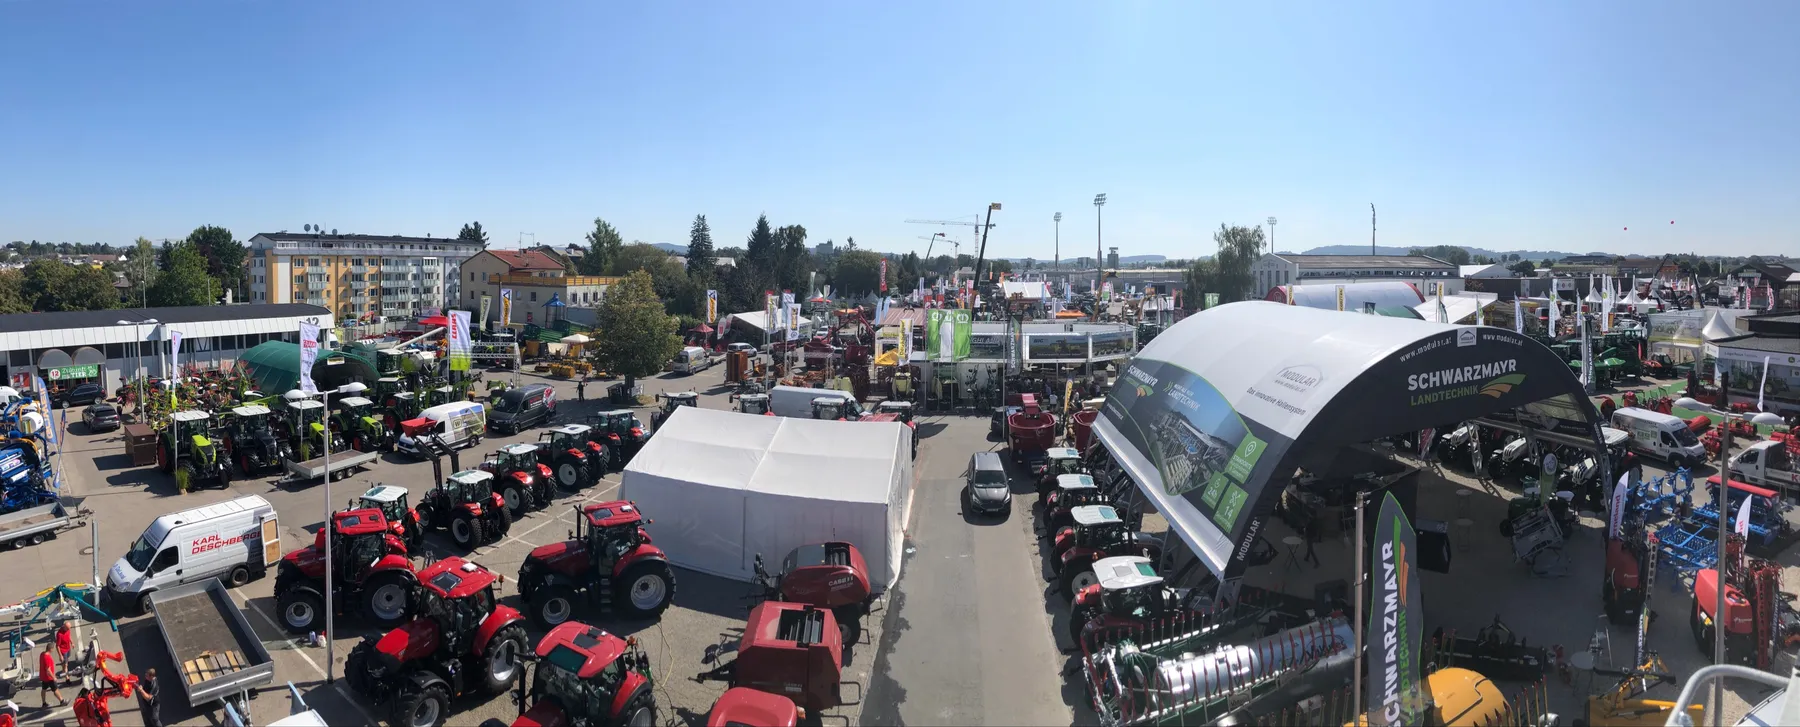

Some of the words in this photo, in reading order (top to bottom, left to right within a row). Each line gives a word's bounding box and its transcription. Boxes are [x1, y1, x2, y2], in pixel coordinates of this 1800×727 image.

[1280, 370, 1316, 387] MODULAR
[1407, 359, 1517, 391] SCHWARZMAYR
[1410, 385, 1479, 406] LANDTECHNIK
[192, 533, 221, 547] KARL
[1237, 519, 1261, 561] MODULAR
